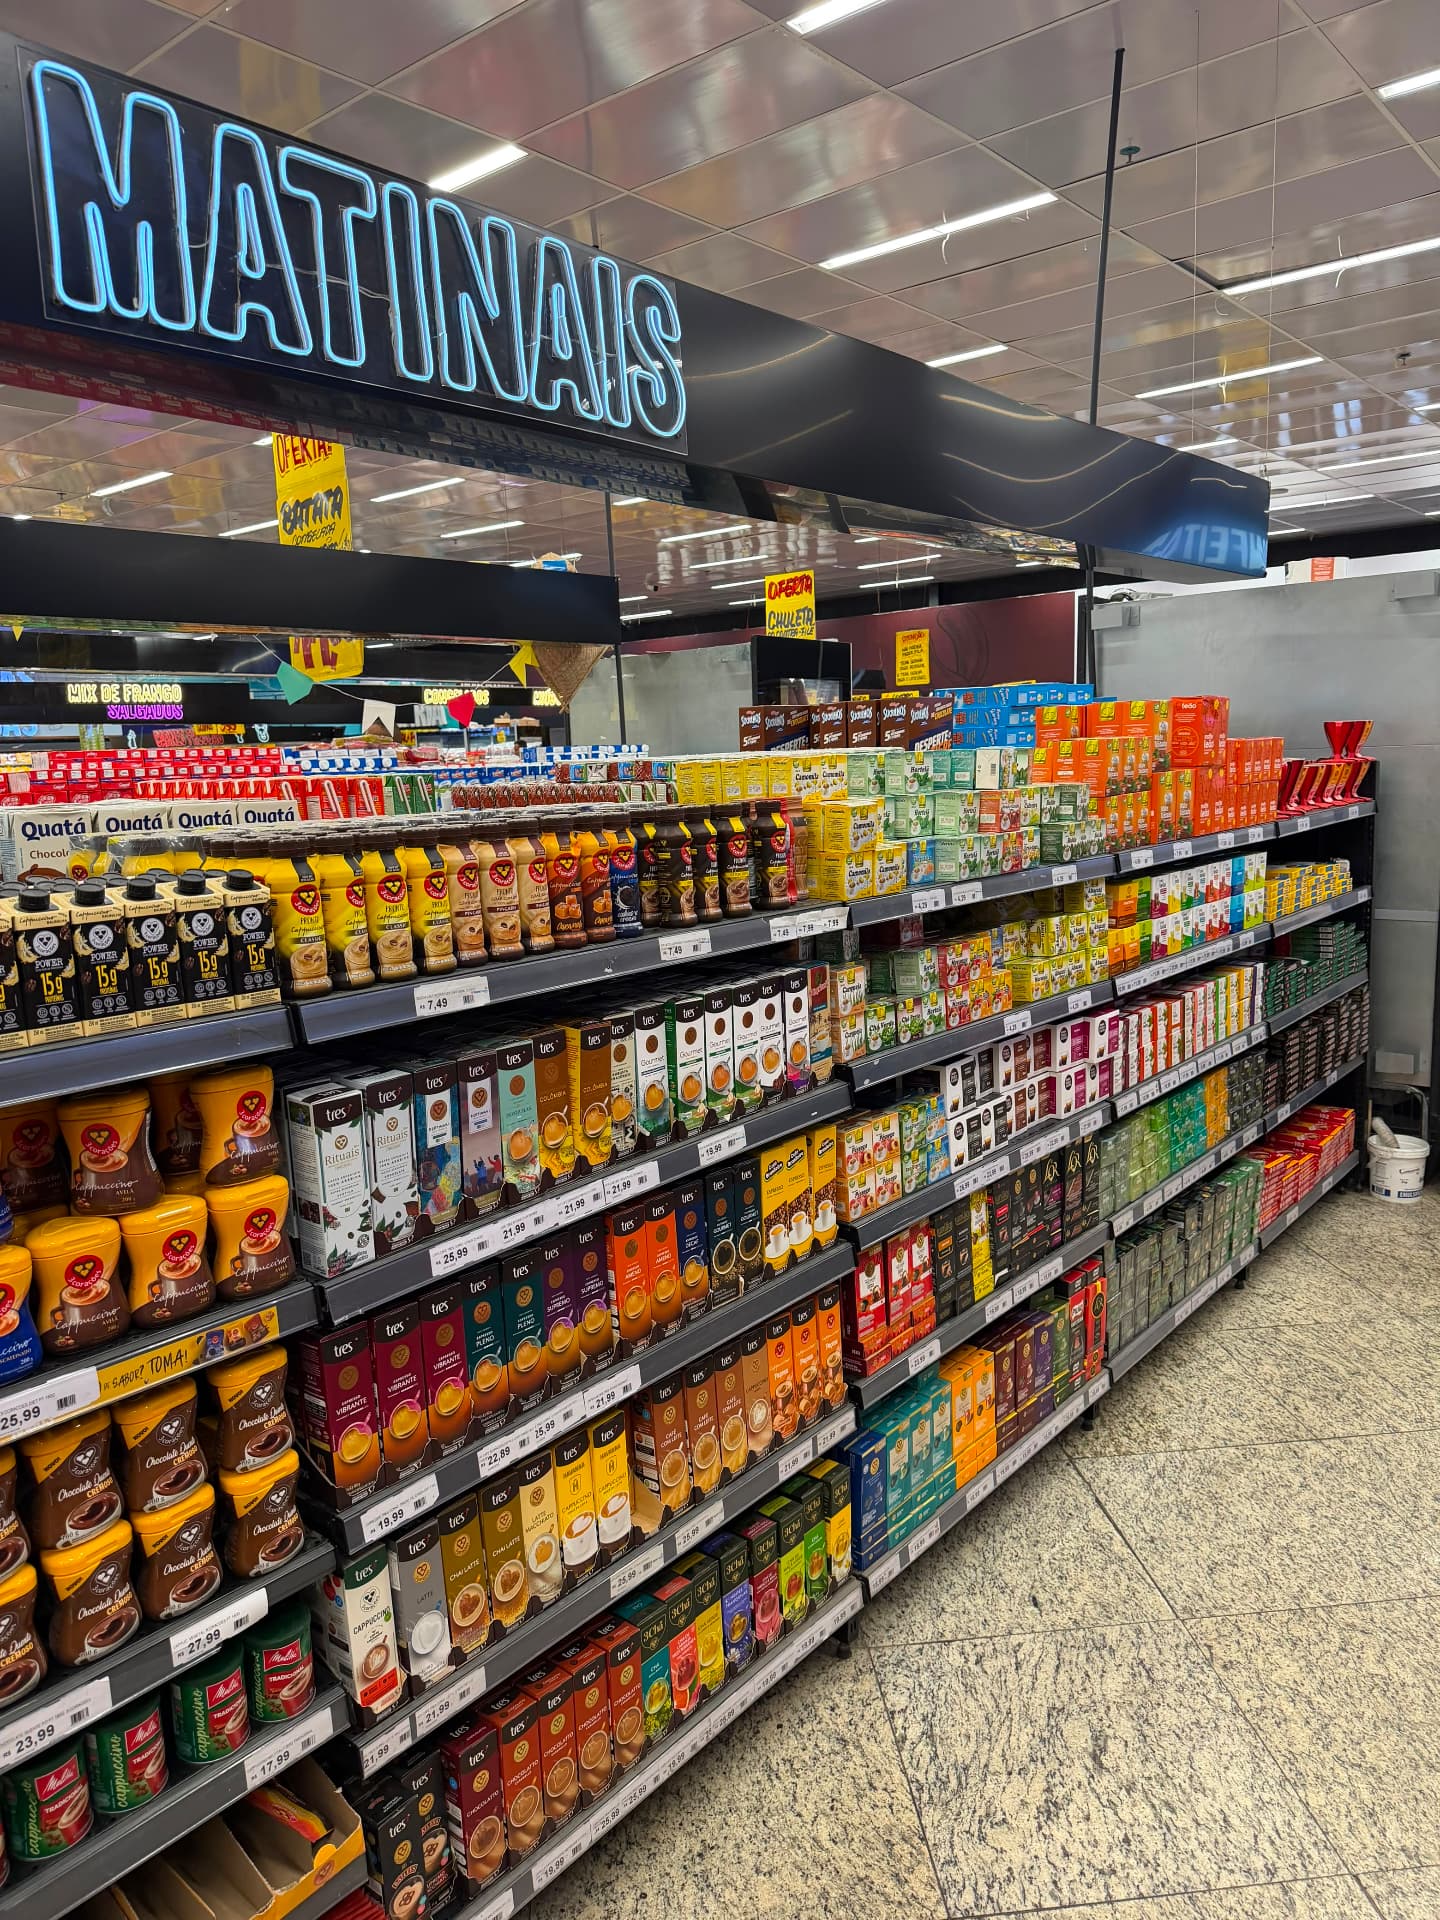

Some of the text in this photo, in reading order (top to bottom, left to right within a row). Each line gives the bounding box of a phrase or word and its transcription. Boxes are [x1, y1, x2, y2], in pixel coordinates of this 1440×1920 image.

[31, 59, 688, 439] MATINAIS
[281, 485, 344, 535] BATATA
[768, 573, 813, 600] OFERTA
[768, 606, 815, 630] CHULETA
[67, 682, 183, 703] MIX DE FRANGO
[107, 704, 184, 720] SALGADOS
[105, 811, 164, 834] Quatá
[178, 808, 234, 829] Quatá
[243, 803, 296, 823] Quatá
[21, 816, 87, 841] Quatá
[193, 937, 218, 949] POWER
[242, 931, 266, 941] POWER
[90, 951, 118, 962] POWER
[143, 943, 169, 955] POWER
[667, 945, 683, 956] 7,49
[35, 957, 64, 970] POWER
[427, 997, 448, 1010] 7,49
[611, 1022, 625, 1035] tres
[426, 1074, 444, 1089] tres
[378, 1088, 398, 1104] tres
[239, 1106, 265, 1122] 3corações
[326, 1105, 347, 1122] tres
[85, 1140, 118, 1156] 3corações
[376, 1130, 409, 1147] Rituais
[230, 1140, 280, 1162] Cappuccino
[324, 1147, 360, 1168] Rituais
[75, 1179, 139, 1193] Cappuccino
[612, 1179, 631, 1195] 21,99
[564, 1199, 585, 1215] 21,99
[681, 1191, 694, 1204] tres
[652, 1204, 665, 1217] tres
[246, 1222, 275, 1240] 3corações
[503, 1223, 526, 1240] 21,99
[165, 1244, 195, 1263] 3corações
[443, 1247, 468, 1265] 25,99
[235, 1255, 290, 1281] Cappuccino
[513, 1262, 529, 1278] tres
[68, 1270, 102, 1289] 3corações
[470, 1278, 487, 1294] tres
[581, 1280, 605, 1294] SUPREMO
[153, 1279, 210, 1308] Cappuccino
[431, 1300, 449, 1316] tres
[546, 1297, 571, 1312] SUPREMO
[55, 1306, 121, 1336] Cappuccino
[386, 1321, 405, 1337] tres
[517, 1317, 536, 1330] PLENO
[334, 1341, 354, 1359] tres
[476, 1334, 495, 1348] PLENO
[112, 1364, 146, 1389] SABOR?
[150, 1349, 189, 1375] TOMA!
[432, 1352, 462, 1371] VIBRANTE
[386, 1374, 418, 1393] VIBRANTE
[335, 1396, 369, 1416] VIBRANTE
[596, 1391, 616, 1409] 21,99
[1, 1405, 41, 1431] 25,99
[238, 1410, 270, 1431] Chocolate
[263, 1411, 287, 1430] CREMOSO
[601, 1427, 615, 1443] tres
[146, 1446, 179, 1469] Chocolate
[173, 1445, 199, 1466] CREMOSO
[487, 1446, 511, 1466] 22,89
[563, 1446, 578, 1461] tres
[526, 1464, 541, 1480] tres
[784, 1457, 799, 1473] 21,99
[58, 1479, 96, 1501] Chocolate
[86, 1478, 114, 1498] CREMOSO
[561, 1491, 592, 1513] CAPPUCCINO
[378, 1508, 405, 1530] 19,99
[531, 1510, 548, 1523] LATTE
[682, 1526, 700, 1544] 25,99
[408, 1537, 427, 1555] tres
[492, 1535, 521, 1557] CHAI LATTE
[163, 1553, 197, 1576] Chocolate
[190, 1551, 214, 1572] CREMOSO
[450, 1558, 480, 1582] CHAI LATTE
[355, 1563, 374, 1583] tres
[617, 1570, 637, 1587] 25,99
[78, 1596, 114, 1621] Chocolate
[106, 1591, 133, 1615] CREMOSO
[353, 1605, 391, 1636] CAPPUCCINO
[187, 1629, 222, 1655] 27,99
[1, 1642, 34, 1666] CREMOSO
[617, 1645, 631, 1661] tres
[582, 1668, 596, 1685] tres
[613, 1682, 642, 1707] CHOCOLATTO
[425, 1700, 450, 1722] 21,99
[578, 1705, 608, 1731] CHOCOLATTO
[510, 1720, 526, 1737] tres
[16, 1724, 56, 1753] 23,99
[543, 1731, 574, 1757] CHOCOLATTO
[260, 1750, 290, 1776] 17,99
[363, 1744, 389, 1769] 21,99
[469, 1748, 485, 1767] tres
[506, 1759, 539, 1786] CHOCOLATTO
[466, 1790, 499, 1818] CHOCOLATTO
[629, 1784, 647, 1805] 25,99
[390, 1819, 406, 1838] tres
[600, 1808, 620, 1830] 25,99
[544, 1856, 565, 1878] 19,99
